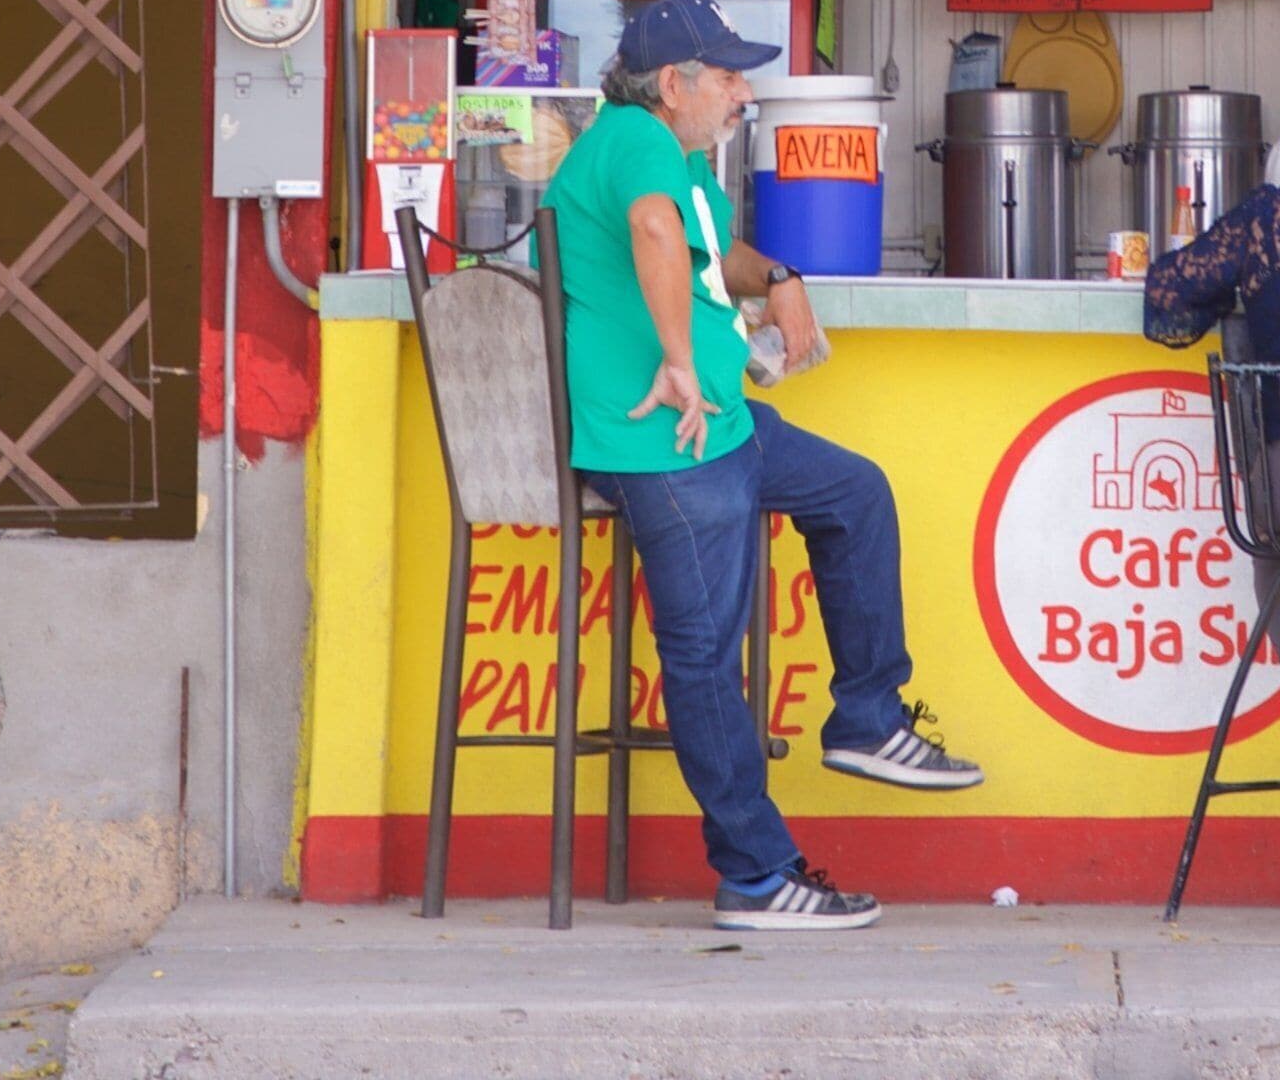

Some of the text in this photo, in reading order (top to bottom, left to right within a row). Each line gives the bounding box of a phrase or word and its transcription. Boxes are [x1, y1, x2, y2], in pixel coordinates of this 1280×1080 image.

[783, 133, 869, 172] AVENA
[1079, 526, 1233, 589] Café
[466, 564, 816, 639] EMPANS
[1037, 603, 1184, 680] Baja
[458, 659, 818, 736] PAN DUE
